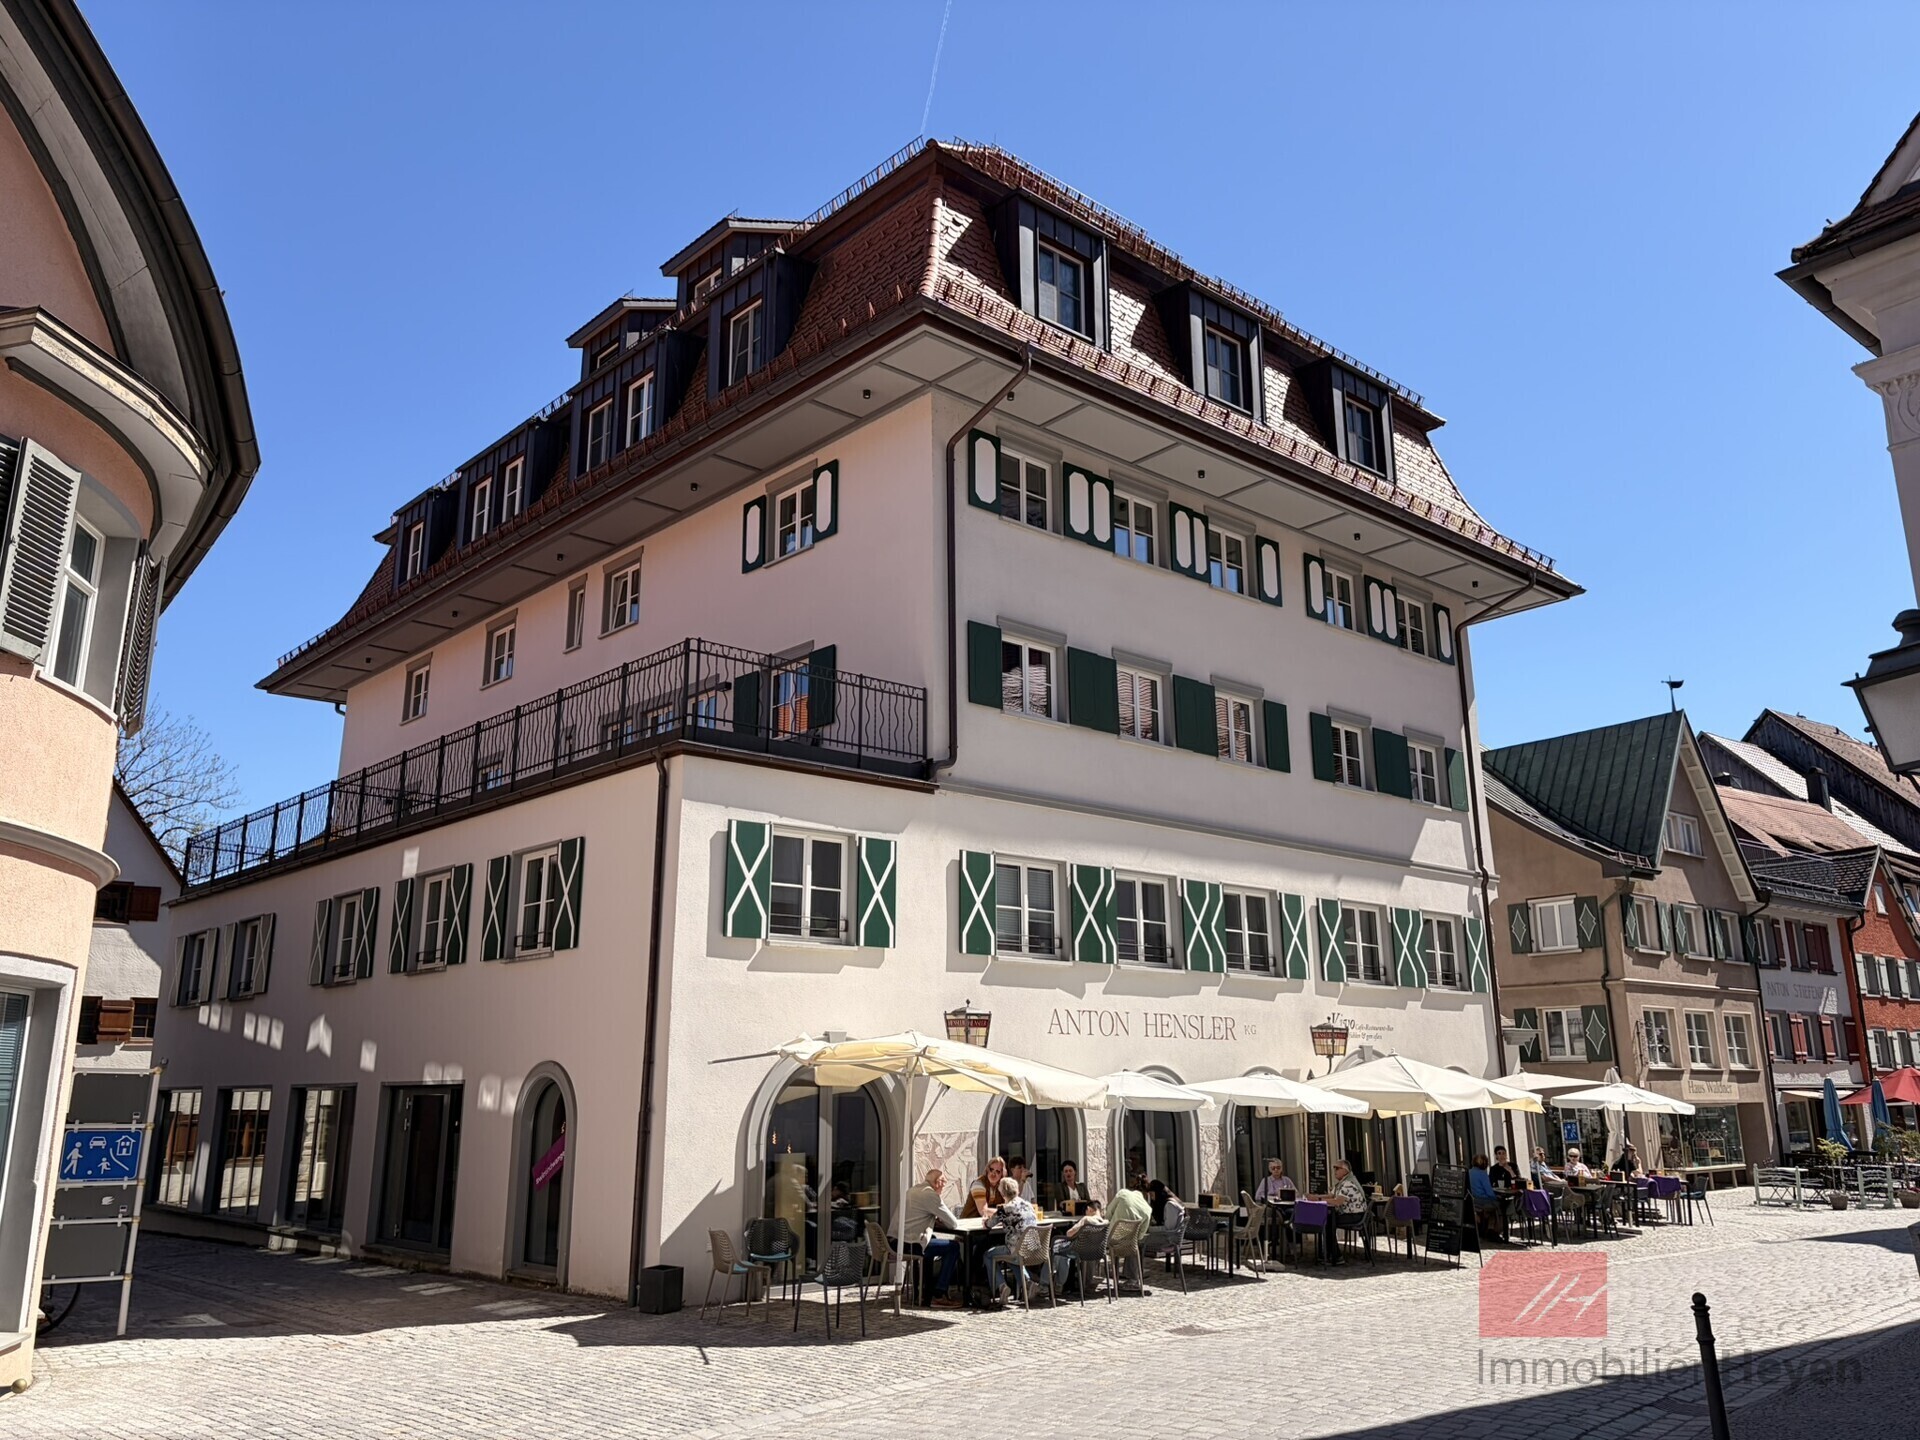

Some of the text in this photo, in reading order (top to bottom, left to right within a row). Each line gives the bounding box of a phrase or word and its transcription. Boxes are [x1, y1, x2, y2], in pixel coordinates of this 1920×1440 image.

[1766, 981, 1790, 997] ANTON
[1047, 1008, 1257, 1041] ANTON HENSLER KG
